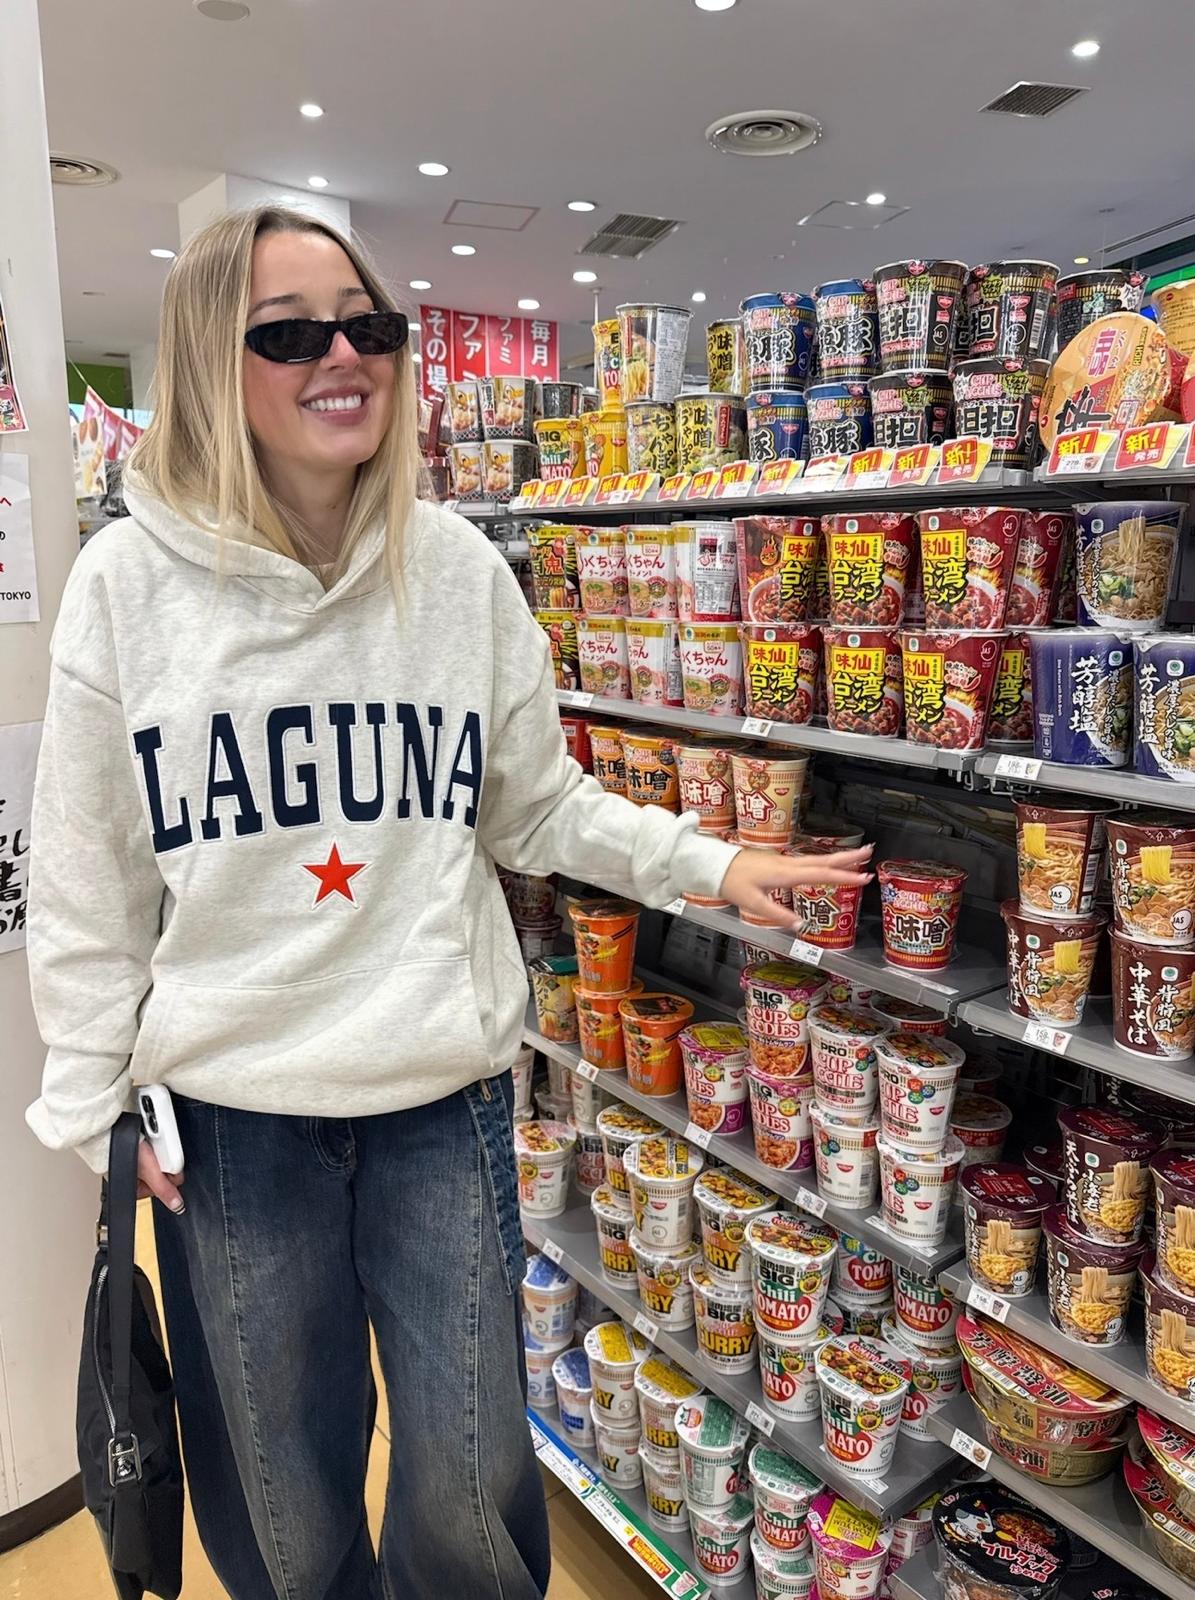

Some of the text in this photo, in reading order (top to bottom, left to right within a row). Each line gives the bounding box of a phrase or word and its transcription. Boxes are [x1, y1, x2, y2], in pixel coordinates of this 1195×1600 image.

[530, 320, 550, 367] 毎月
[692, 405, 713, 449] 味噌
[1058, 433, 1091, 456] 新!
[1124, 429, 1162, 456] 新!
[834, 539, 870, 558] 味仙
[831, 560, 884, 588] 台湾
[832, 586, 882, 602] ラーメン
[753, 647, 787, 665] 味仙
[835, 653, 872, 672] 味仙
[750, 664, 799, 690] 台湾
[832, 671, 885, 700] 台湾
[751, 688, 797, 704] ラーメン
[833, 697, 883, 714] ラーメン
[1069, 655, 1102, 733] 芳醇塩
[1138, 663, 1161, 745] 芳醇塩
[132, 701, 485, 857] LAGUNA
[752, 987, 783, 1005] BIG
[1127, 961, 1152, 1045] 中華そば
[751, 1005, 788, 1024] CUP
[750, 1016, 800, 1039] OODLES
[704, 1248, 740, 1272] RRY
[851, 1262, 893, 1281] TOMA
[758, 1265, 796, 1287] BIG
[758, 1280, 796, 1304] Chili
[897, 1279, 936, 1306] Chili
[707, 1308, 742, 1323] BIG
[756, 1292, 811, 1321] OMATO
[896, 1292, 951, 1324] OMATO
[825, 1431, 870, 1457] MATO
